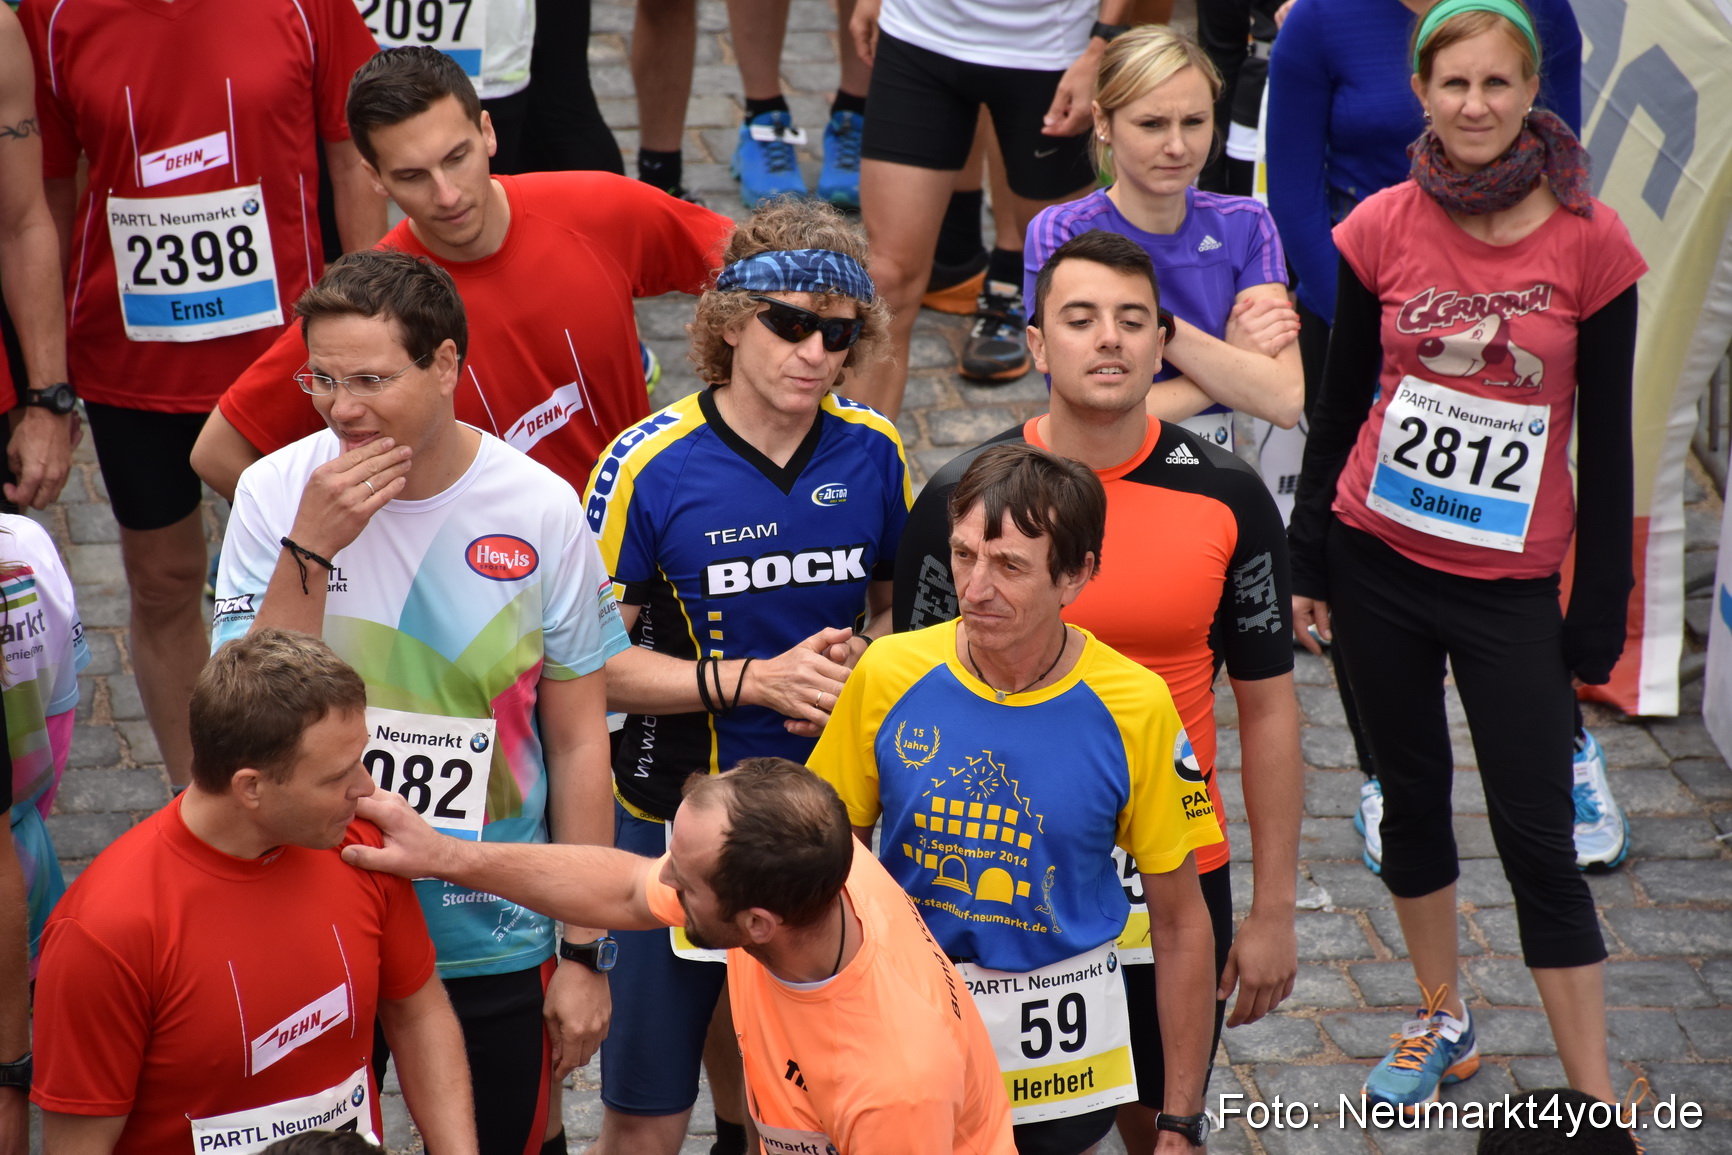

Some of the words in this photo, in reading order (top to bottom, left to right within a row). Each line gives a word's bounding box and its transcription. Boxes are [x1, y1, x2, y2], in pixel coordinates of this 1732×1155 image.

[165, 149, 203, 172] DEHN
[111, 211, 157, 227] PARTL
[160, 206, 237, 226] Neumarkt
[127, 225, 258, 286] 2398
[171, 296, 225, 321] Ernst
[527, 402, 563, 437] DEHN
[1398, 389, 1444, 415] PARTL
[1447, 405, 1523, 433] Neumarkt
[1165, 456, 1200, 465] adidas
[1393, 416, 1529, 493] 2812
[586, 408, 682, 534] BOCK
[1410, 487, 1482, 523] Sabine
[704, 522, 778, 545] TEAM
[476, 545, 530, 569] Hervis
[704, 546, 868, 597] BOCK
[376, 725, 462, 749] Neumarkt
[903, 740, 929, 752] Jahre
[912, 728, 925, 738] 15
[999, 850, 1028, 867] 2014
[1028, 962, 1103, 991] Neumarkt
[278, 1009, 322, 1049] DEHN
[1020, 992, 1087, 1060] 59
[1013, 1066, 1095, 1102] Herbert
[200, 1126, 268, 1152] PARTL
[271, 1099, 348, 1138] Neumarkt
